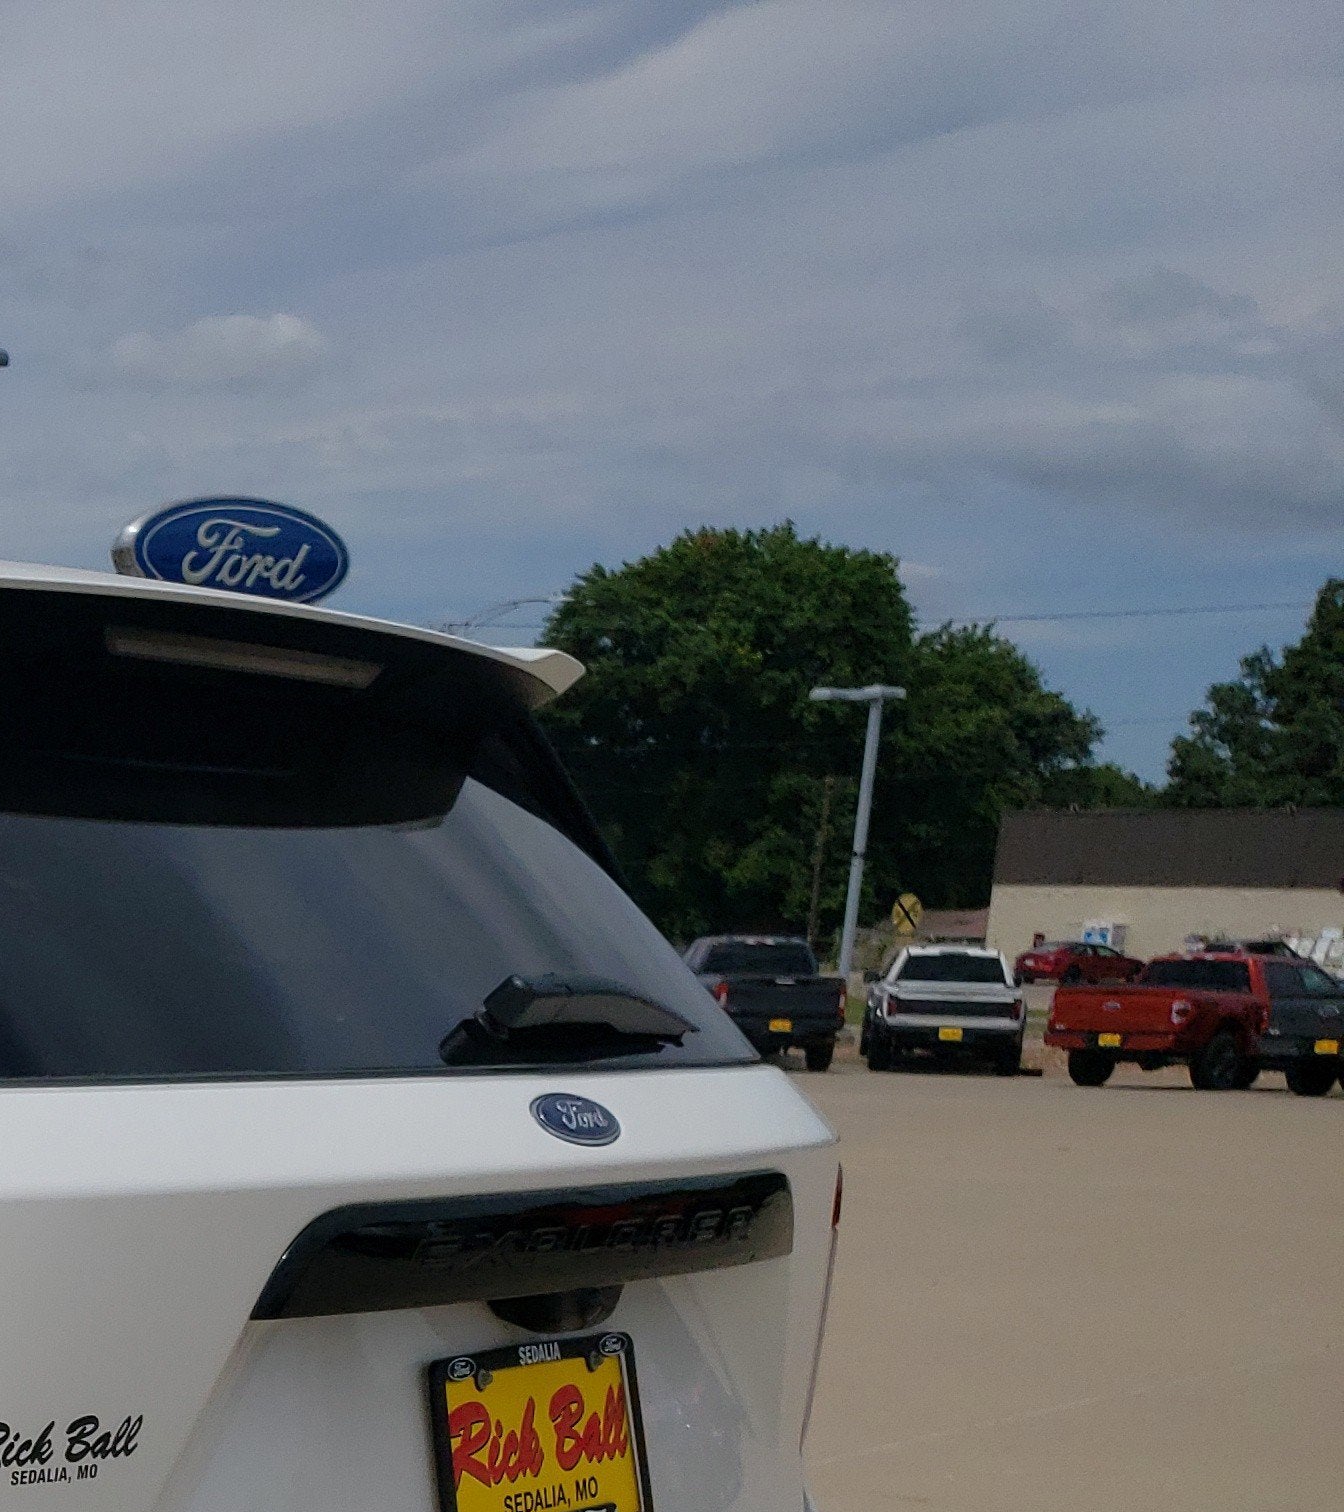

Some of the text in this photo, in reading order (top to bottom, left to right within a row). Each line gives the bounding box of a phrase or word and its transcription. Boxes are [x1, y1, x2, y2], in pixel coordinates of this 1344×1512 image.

[181, 518, 311, 591] Ford
[555, 1100, 609, 1130] Ford
[518, 1342, 561, 1365] SEDALIA
[64, 1414, 143, 1462] Ball
[448, 1382, 627, 1488] Rick Ball
[10, 1463, 98, 1485] SEDALIA, MO
[575, 1475, 599, 1502] MO
